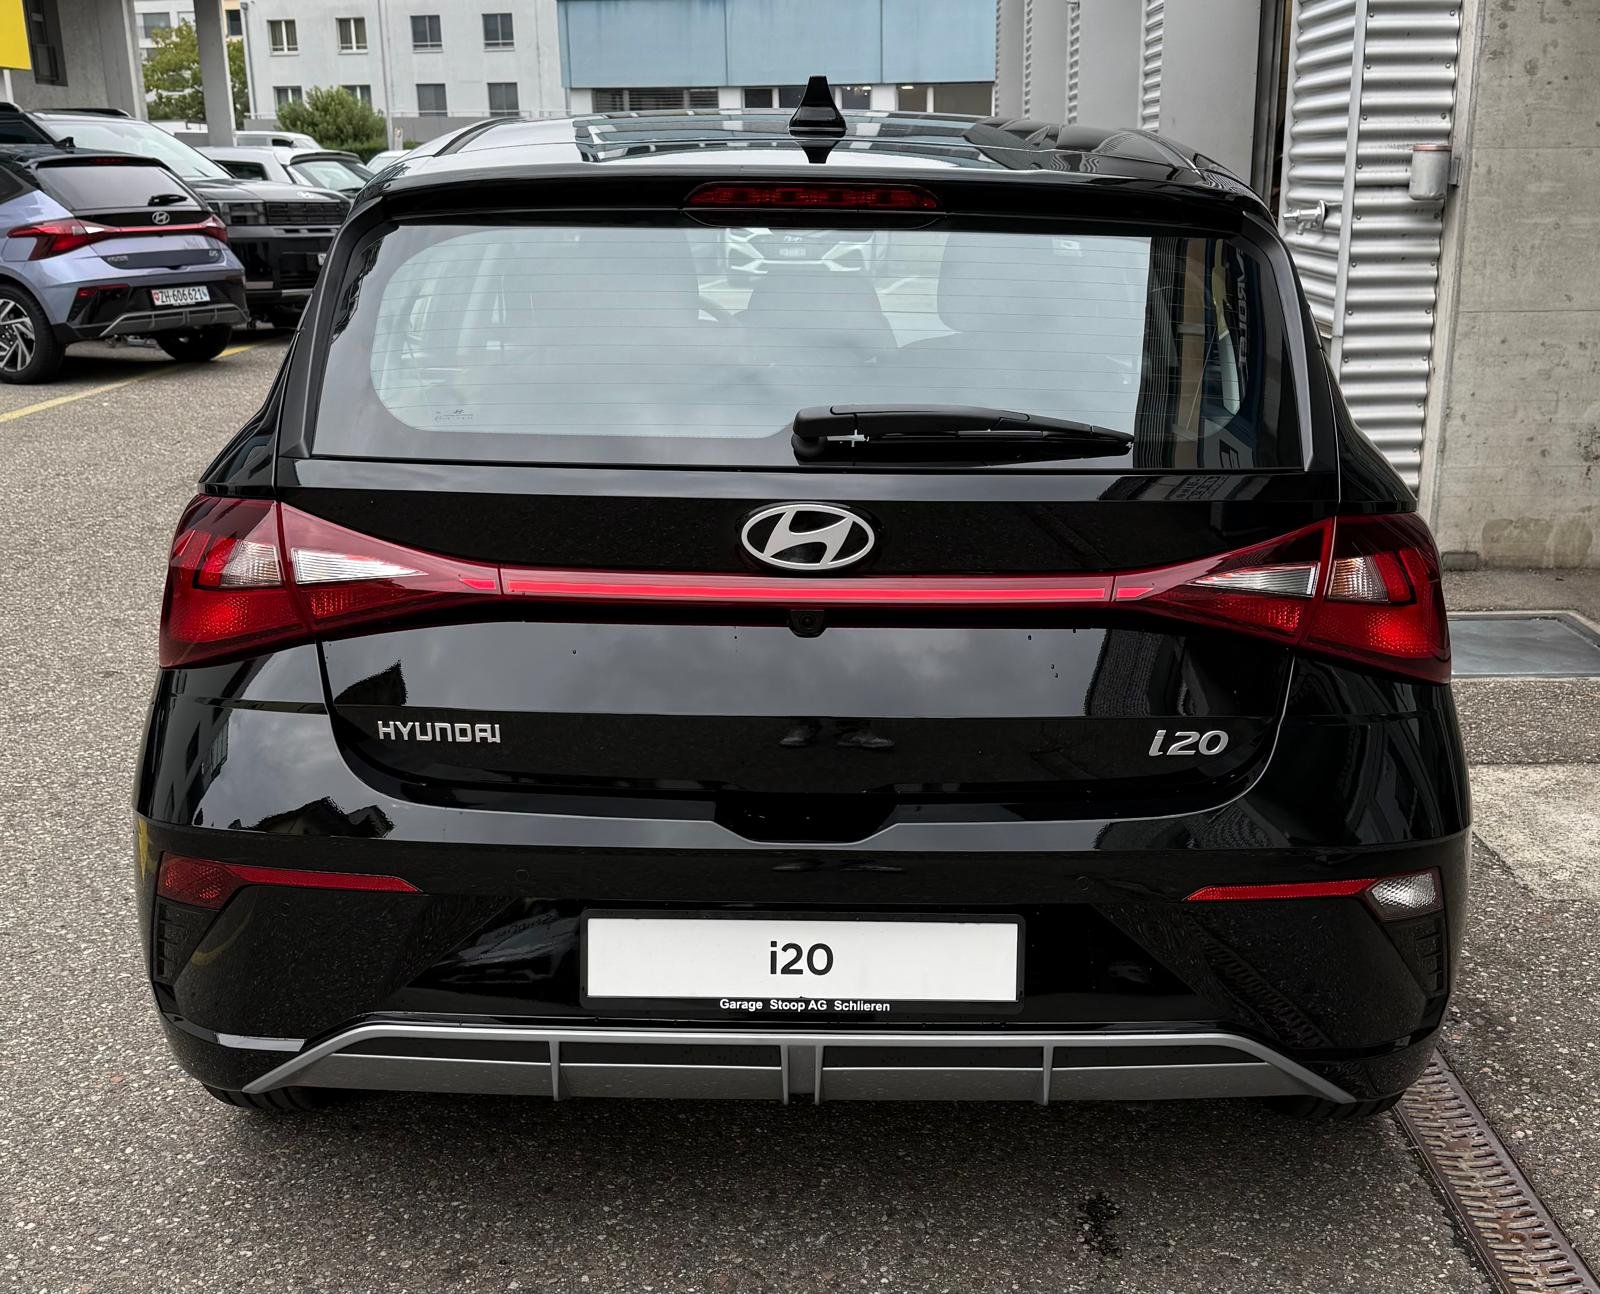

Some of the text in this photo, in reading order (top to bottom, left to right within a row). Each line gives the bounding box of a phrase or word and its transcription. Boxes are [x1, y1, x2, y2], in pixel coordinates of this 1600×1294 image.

[377, 720, 501, 744] HYUNDAI
[1148, 729, 1229, 757] i20
[769, 940, 834, 976] i20
[719, 998, 891, 1012] Garage Stoop AG Schlieren
